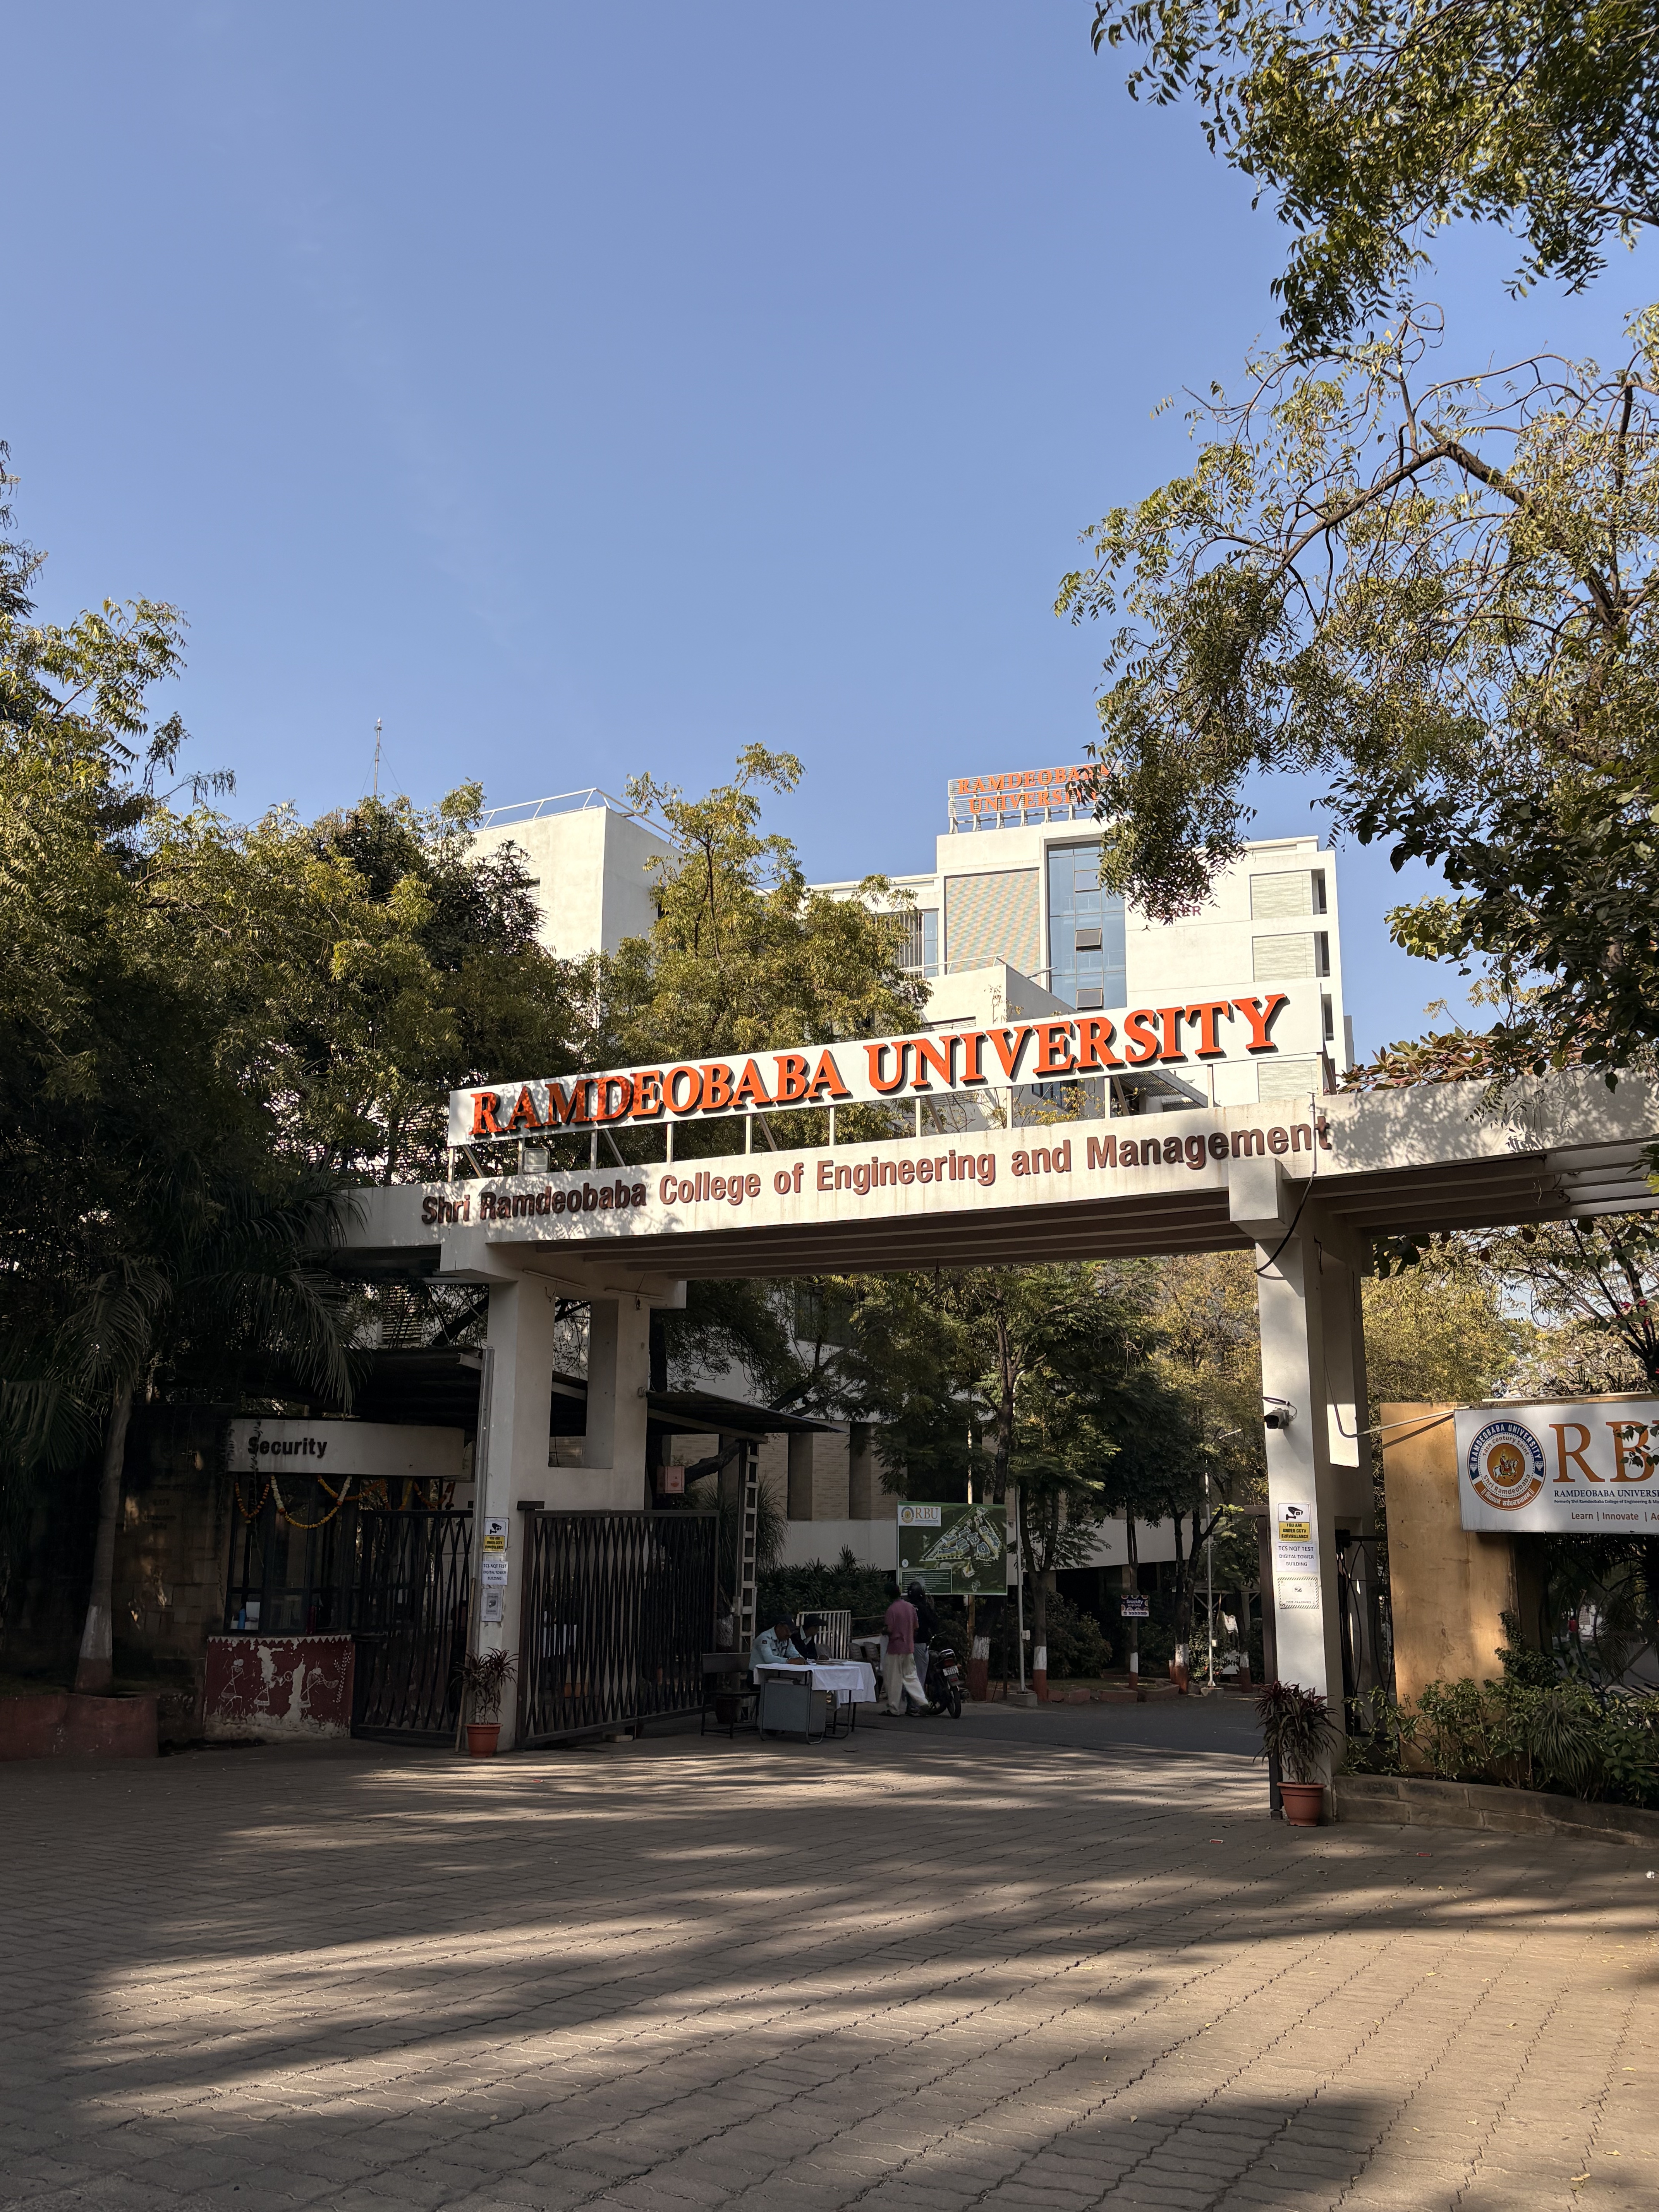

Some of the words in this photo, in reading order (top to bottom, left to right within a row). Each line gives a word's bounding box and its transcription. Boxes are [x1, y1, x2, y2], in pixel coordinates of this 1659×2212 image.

[969, 786, 1097, 814] UNIVERSI
[469, 1049, 850, 1135] RAMDEOBABA
[863, 993, 1286, 1094] UNIVERSITY
[422, 1194, 471, 1224] Shri
[480, 1179, 647, 1220] Ramdeobaba
[659, 1171, 761, 1206] College
[774, 1162, 804, 1194] of
[816, 1149, 996, 1195] Engineering
[1011, 1139, 1071, 1176] and
[1087, 1115, 1332, 1170] Management
[248, 1436, 328, 1459] Security
[1471, 1424, 1505, 1462] RAMDEOBABA
[1508, 1424, 1542, 1459] UNIVERSITY
[1549, 1420, 1659, 1483] RB
[1483, 1475, 1494, 1488] Shri
[1494, 1474, 1531, 1494] Ramdeobaba
[915, 1507, 939, 1519] RBU
